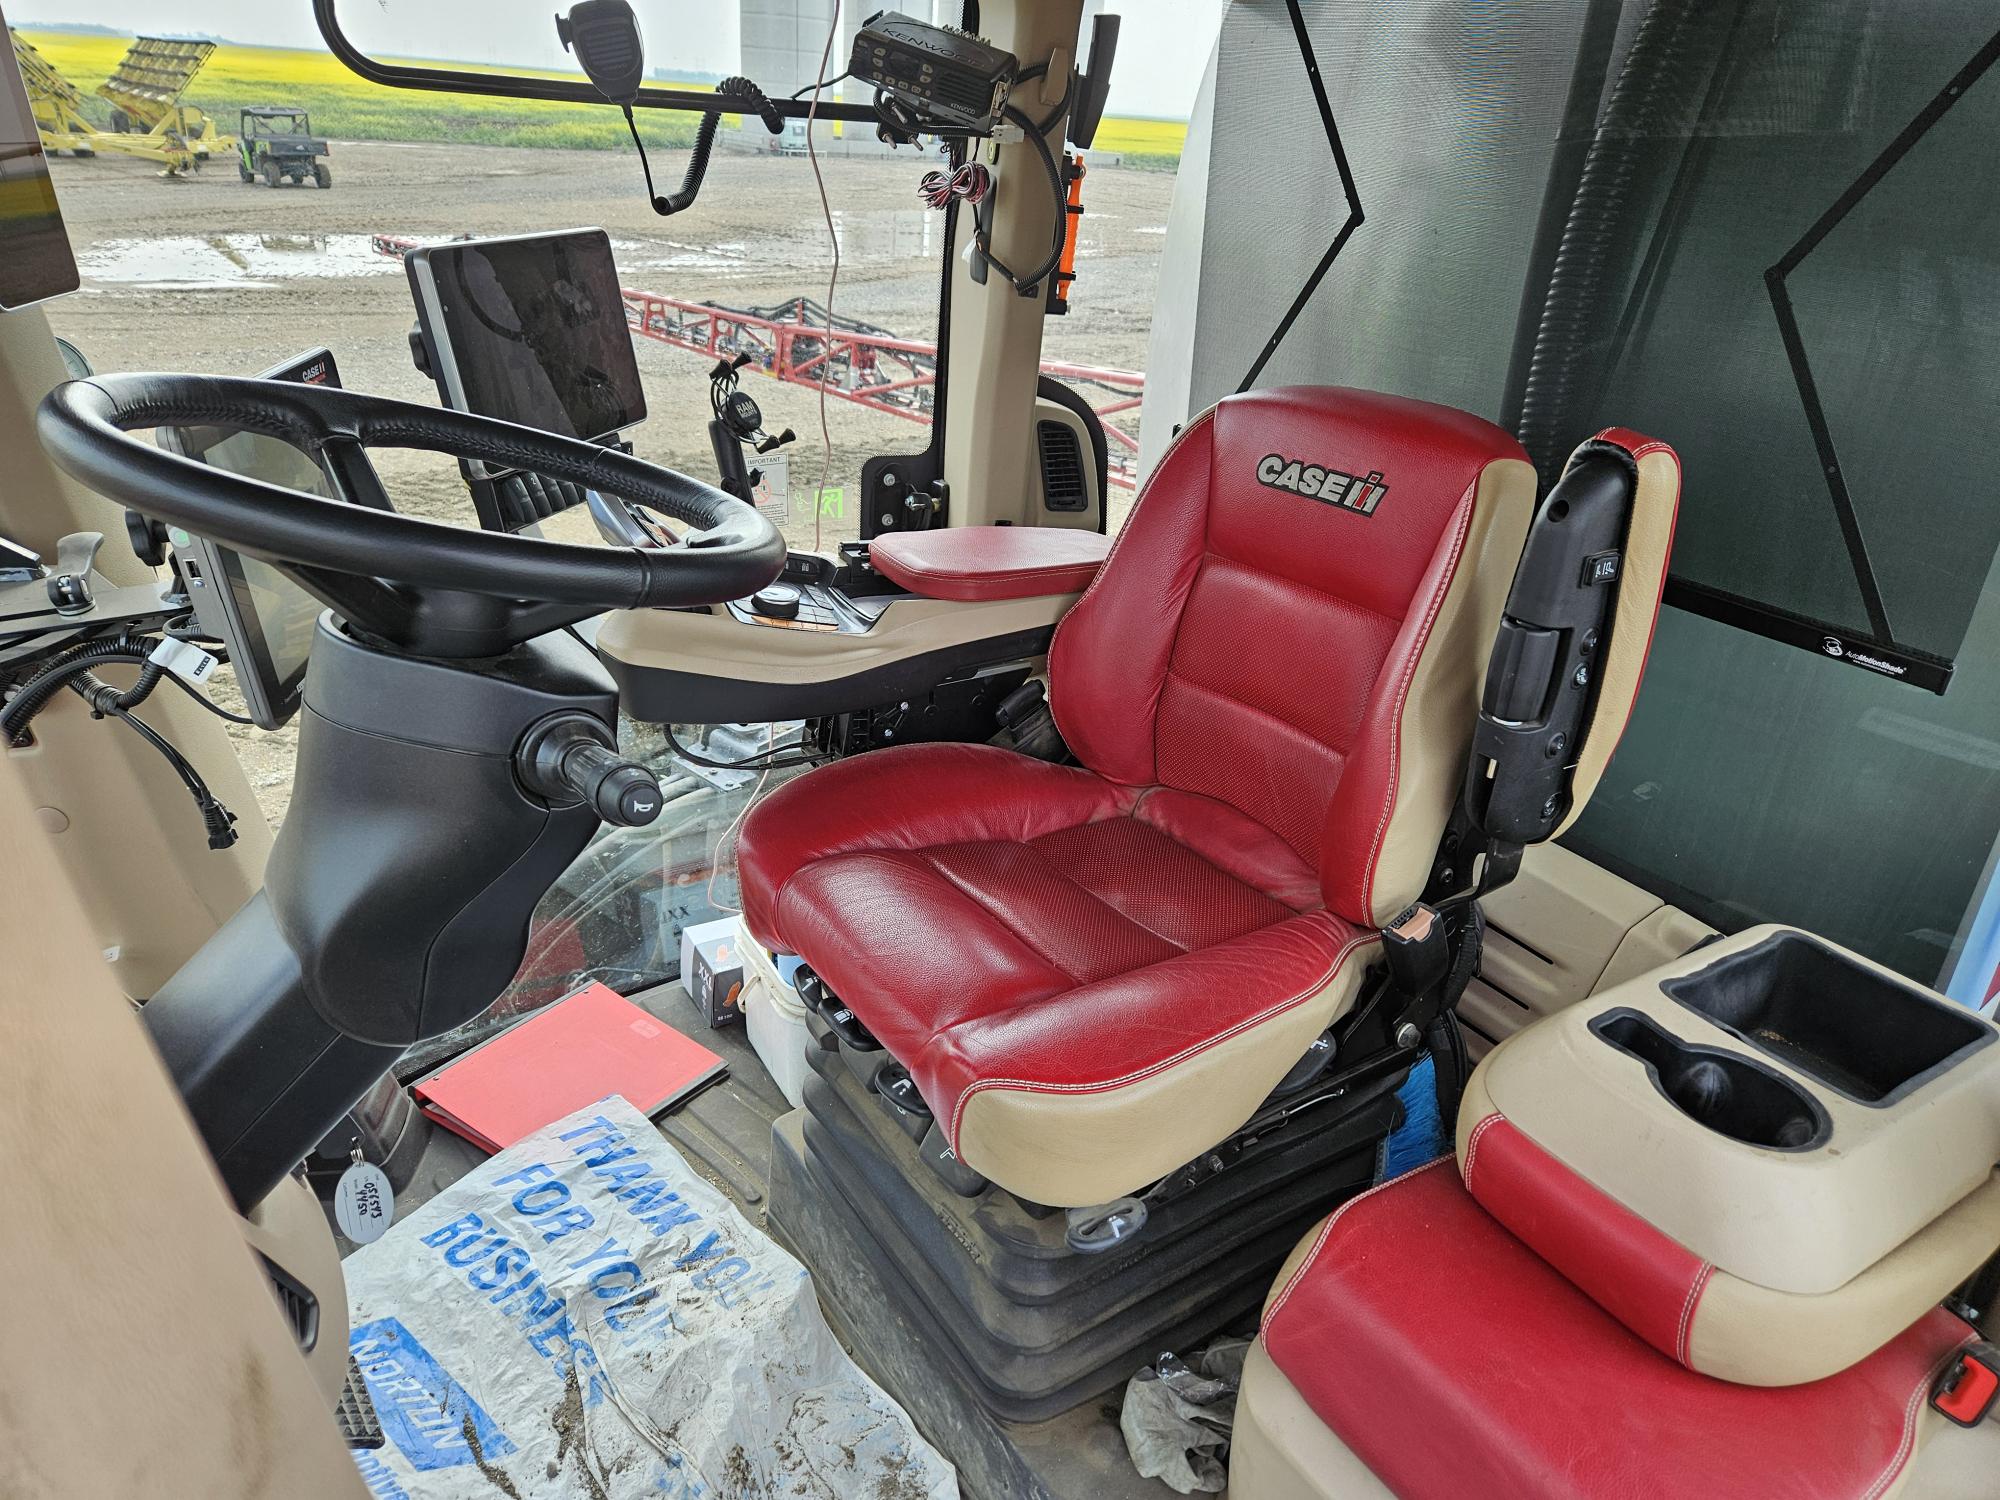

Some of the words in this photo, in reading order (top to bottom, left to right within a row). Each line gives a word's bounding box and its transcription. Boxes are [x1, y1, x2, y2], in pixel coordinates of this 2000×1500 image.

[950, 103, 976, 115] KENWOOD
[736, 400, 755, 415] RAM
[747, 456, 781, 465] IMPORTANT
[559, 1114, 704, 1238] THANK
[490, 1162, 596, 1244] FOR
[350, 1338, 468, 1452] NORTON
